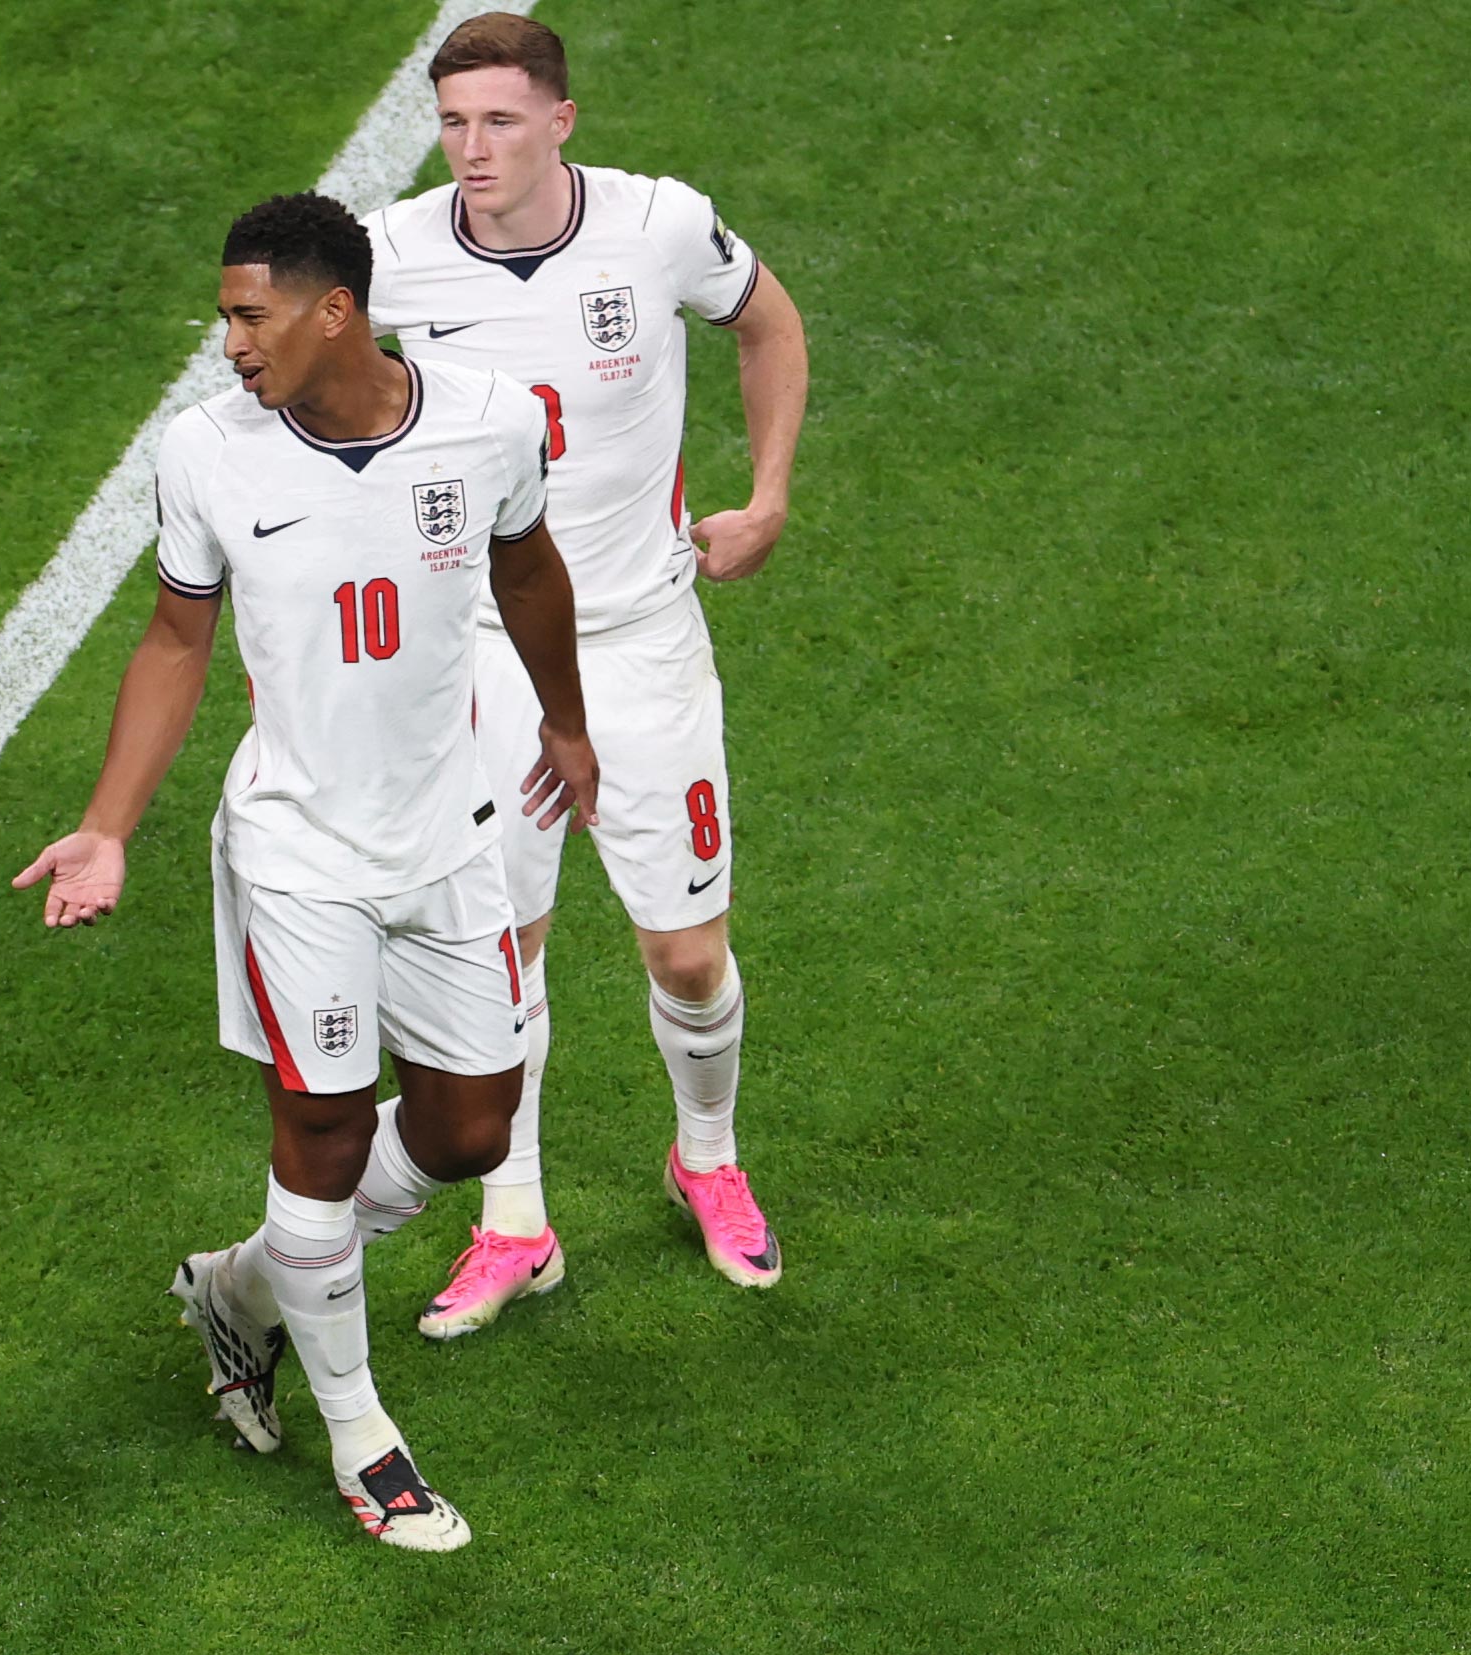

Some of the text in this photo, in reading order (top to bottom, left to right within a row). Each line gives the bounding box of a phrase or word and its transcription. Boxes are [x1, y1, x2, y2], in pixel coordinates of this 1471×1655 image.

[589, 354, 641, 370] ARGENTINA
[421, 545, 468, 561] ARGENTINA
[334, 577, 400, 663] 10
[686, 779, 721, 861] 8
